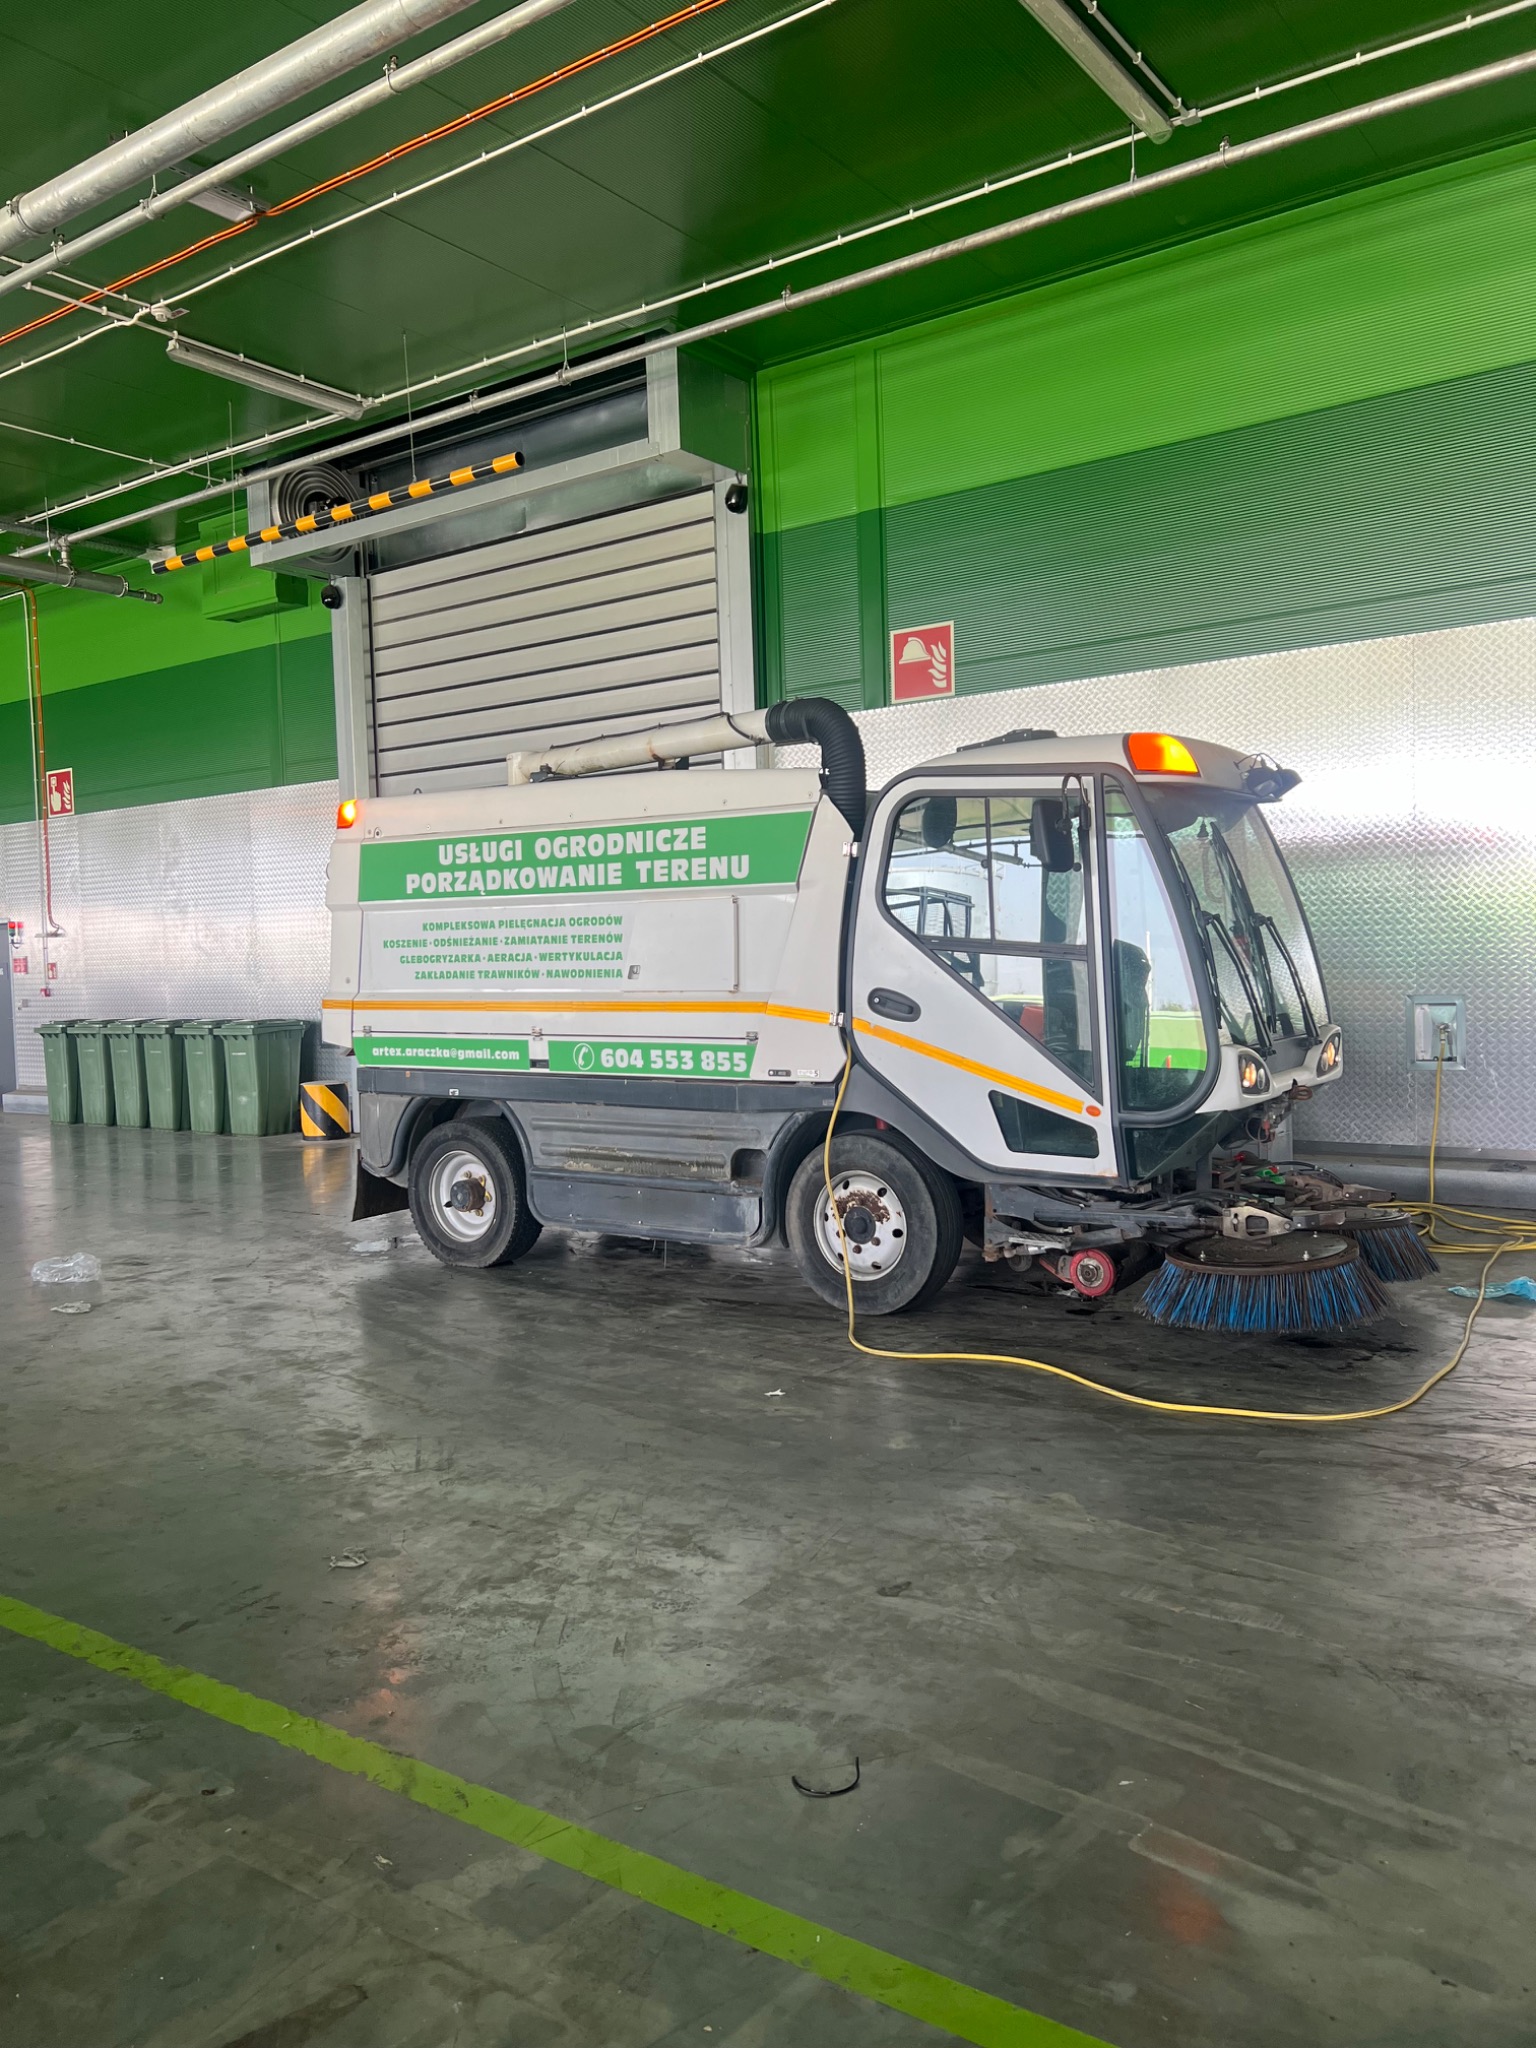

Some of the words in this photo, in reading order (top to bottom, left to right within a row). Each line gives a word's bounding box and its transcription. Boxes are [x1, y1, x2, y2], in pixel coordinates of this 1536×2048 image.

[438, 839, 522, 866] USŁUGI
[534, 826, 706, 860] OGRODNICZE
[405, 862, 622, 895] PORZĄDKOWANIE
[635, 854, 750, 884] TERENU
[422, 920, 496, 932] KOMPLEKSOWA
[498, 918, 566, 930] PIELĘGNACJA
[569, 914, 623, 927] OGRODÓW
[383, 939, 428, 949] KOSZENIE
[433, 936, 498, 947] ODŚNIEŻANIE
[504, 935, 568, 946] ZAMIATANIE
[570, 931, 623, 944] TERENÓW
[400, 954, 481, 964] GLEBOGRYZARKA
[487, 953, 533, 962] AERACJA
[539, 951, 623, 961] WERTYKULACJA
[415, 970, 475, 980] ZAKŁADANIE
[477, 968, 540, 979] TRAWNIKÓW
[546, 969, 623, 979] NAWODNIENIA
[372, 1046, 520, 1060] artex.araczka@gmail.com
[600, 1048, 644, 1069] 604
[650, 1049, 694, 1070] 553
[701, 1050, 747, 1073] 855
